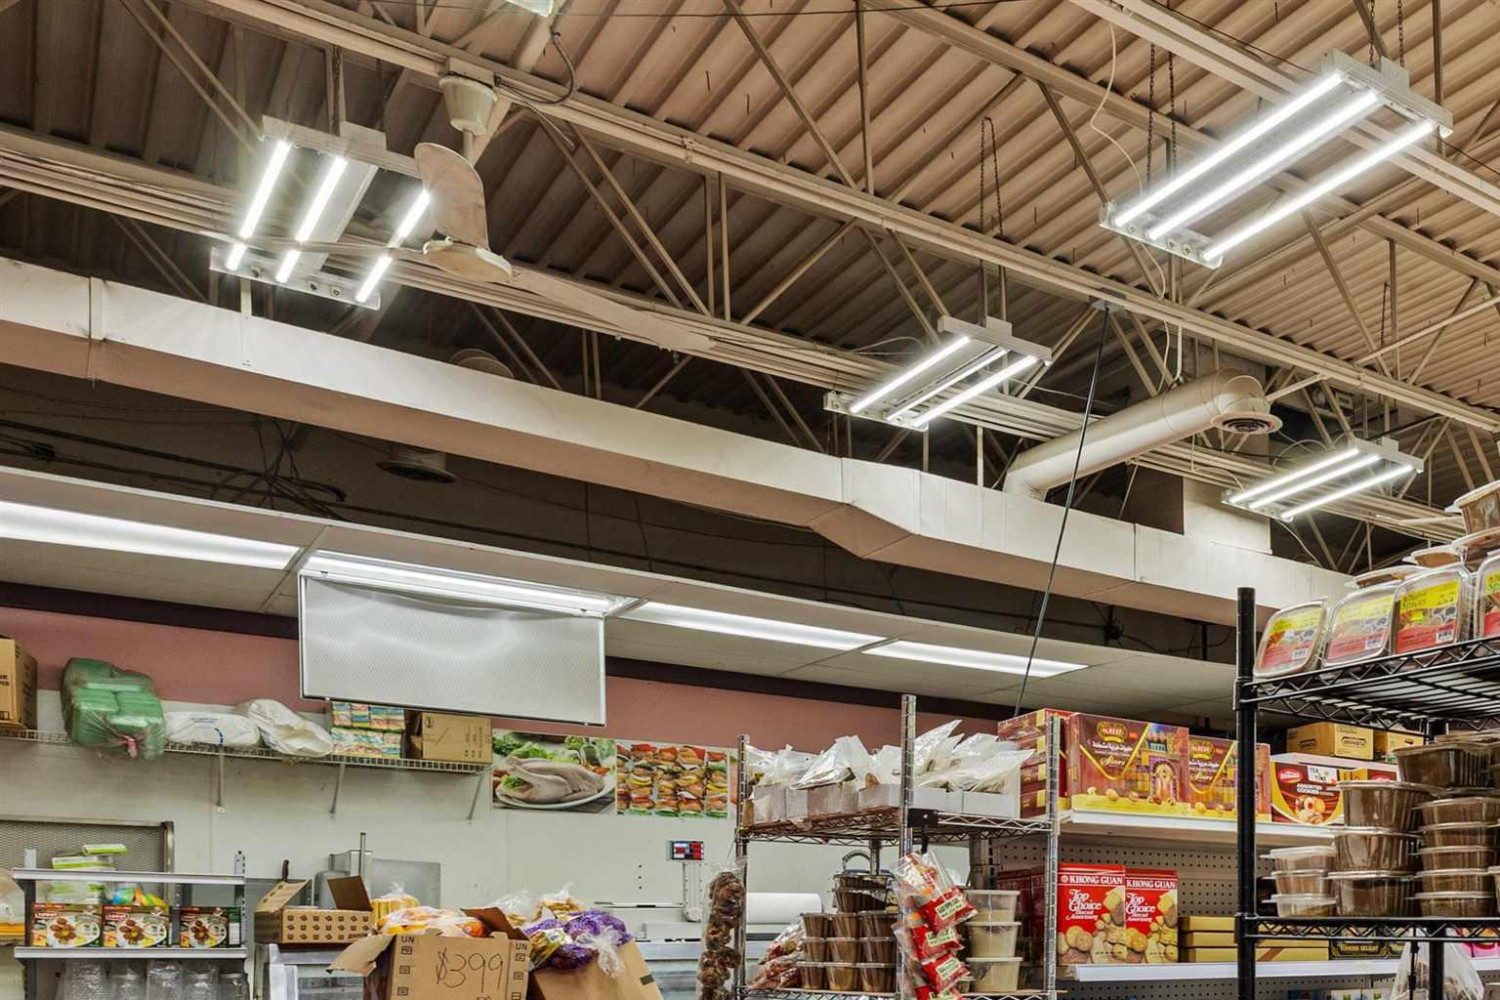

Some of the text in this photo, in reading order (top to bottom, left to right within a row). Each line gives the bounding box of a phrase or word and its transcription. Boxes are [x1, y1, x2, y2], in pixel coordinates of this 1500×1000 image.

[1069, 875, 1123, 885] KHONG GUAN
[1126, 880, 1176, 889] KHONG GUAN
[1069, 889, 1089, 901] Top
[1126, 893, 1145, 903] Top
[1069, 900, 1102, 912] Choice
[1126, 903, 1156, 914] Choice
